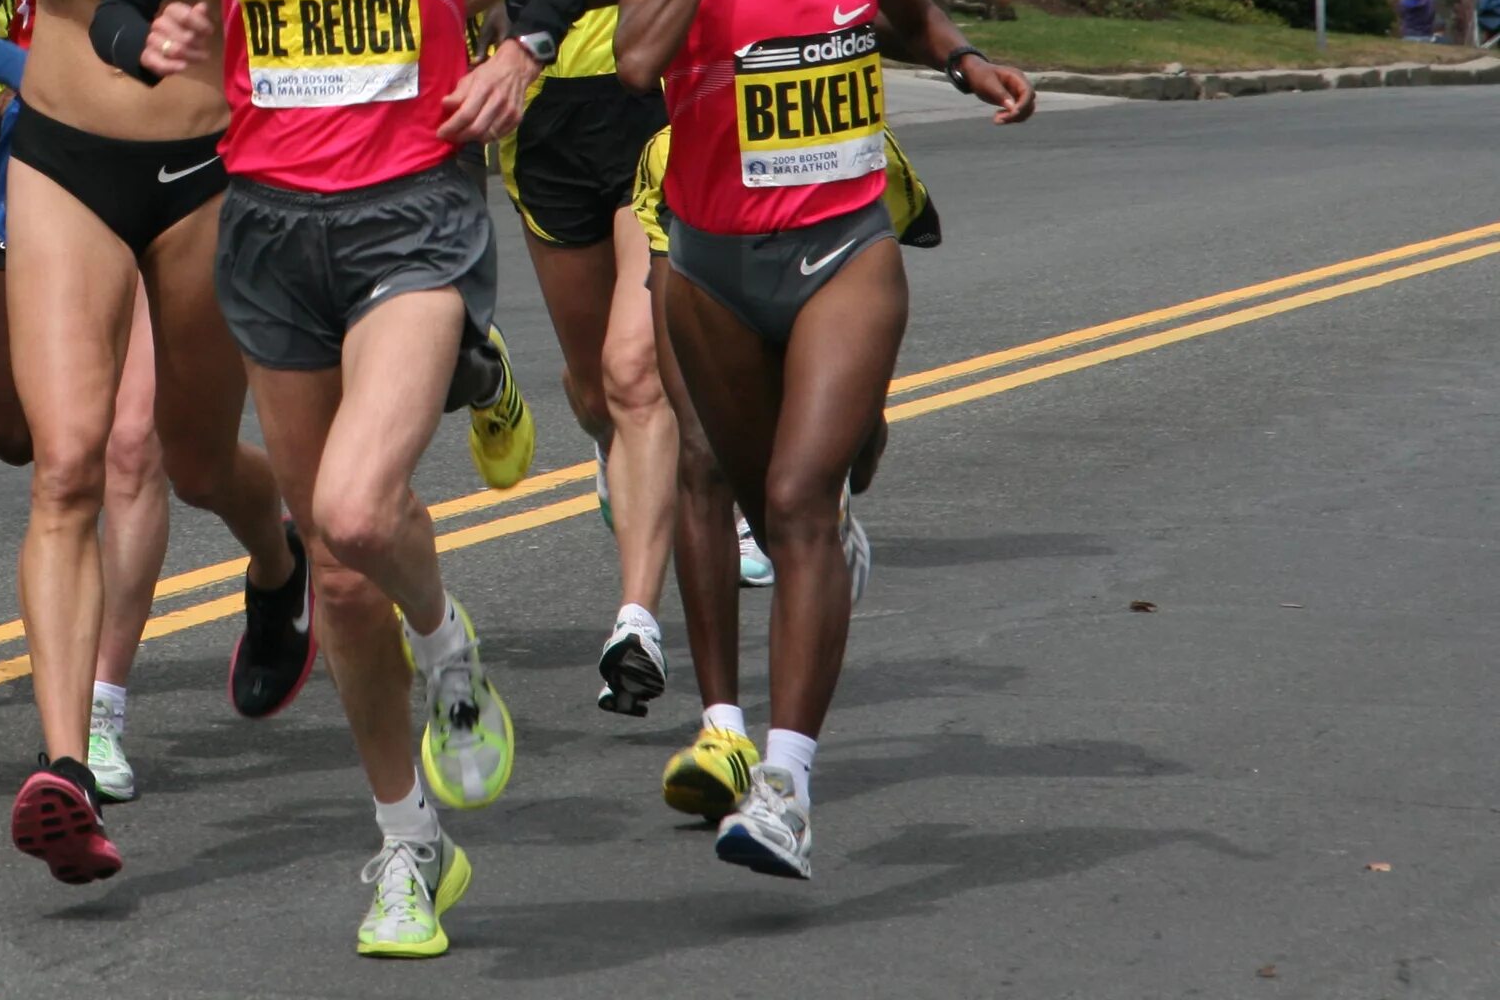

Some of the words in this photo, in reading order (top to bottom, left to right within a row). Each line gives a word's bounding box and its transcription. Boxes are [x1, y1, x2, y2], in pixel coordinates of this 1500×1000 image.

[803, 32, 876, 63] adidas
[277, 76, 299, 85] 2009
[302, 75, 344, 84] BOSTON
[277, 84, 344, 96] MARATHON
[744, 64, 881, 142] BEKELE
[772, 155, 796, 165] 2009
[799, 151, 838, 162] BOSTON
[773, 161, 839, 174] MARATHON
